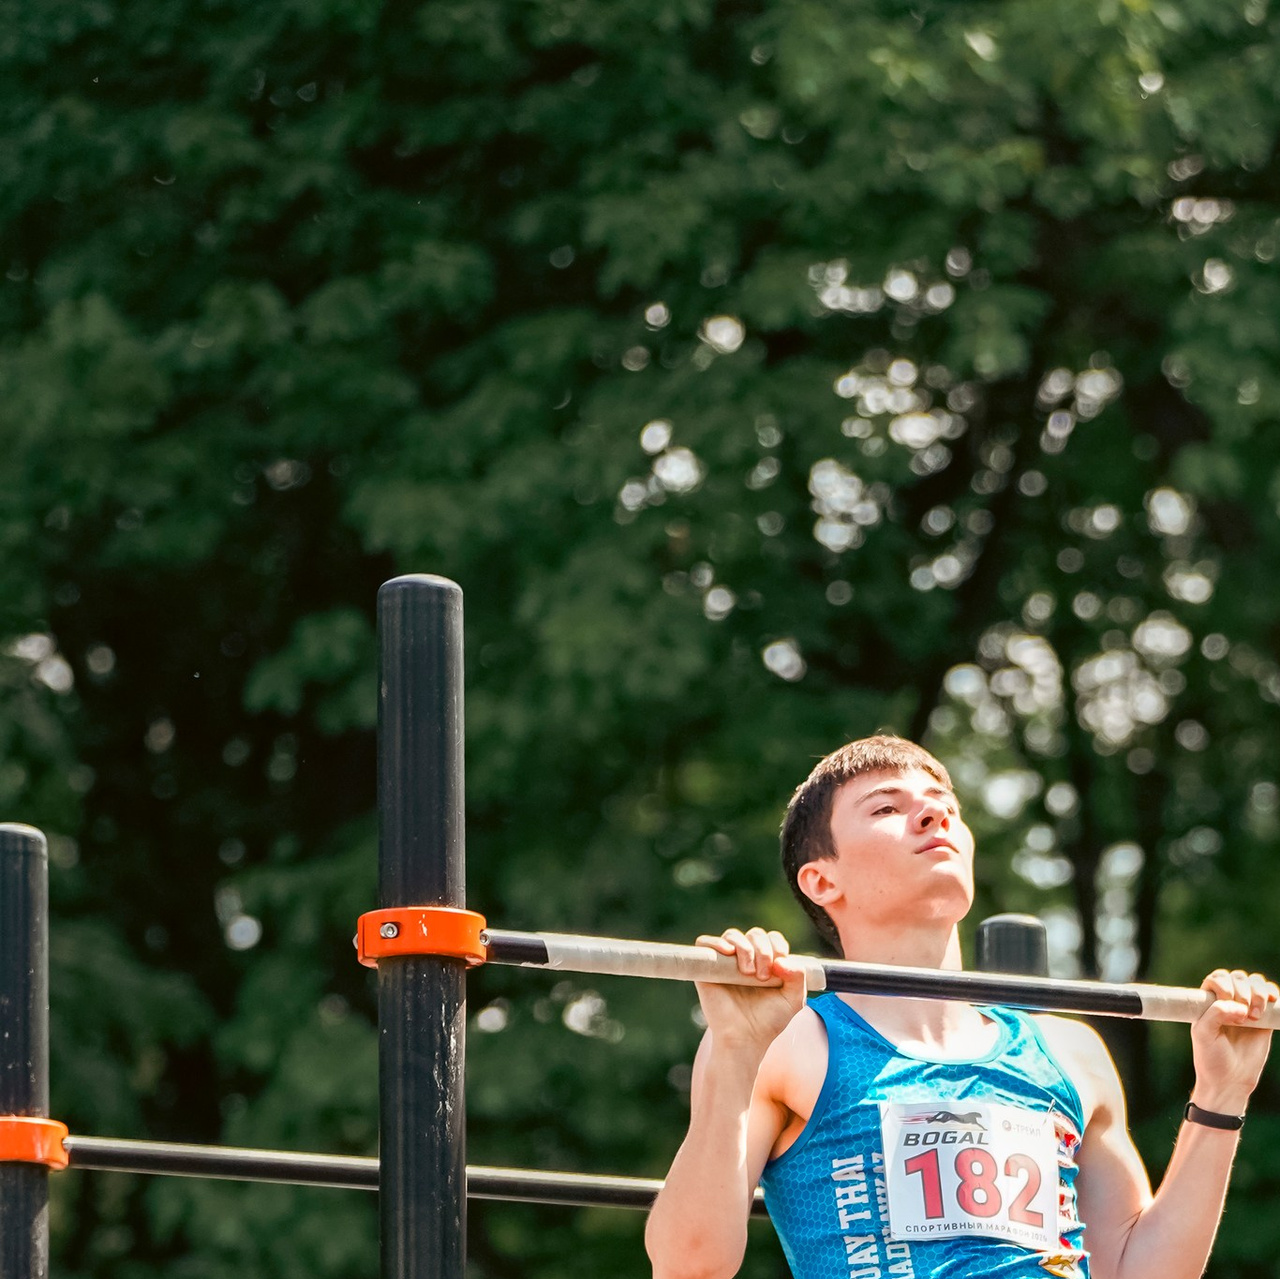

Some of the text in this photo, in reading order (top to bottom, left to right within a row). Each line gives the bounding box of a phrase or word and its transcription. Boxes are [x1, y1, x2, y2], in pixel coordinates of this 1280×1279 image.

[903, 1130, 989, 1147] BOGAL
[831, 1154, 872, 1230] THAI
[904, 1147, 1044, 1229] 182
[905, 1221, 983, 1233] СПОРТИВНЫЙ
